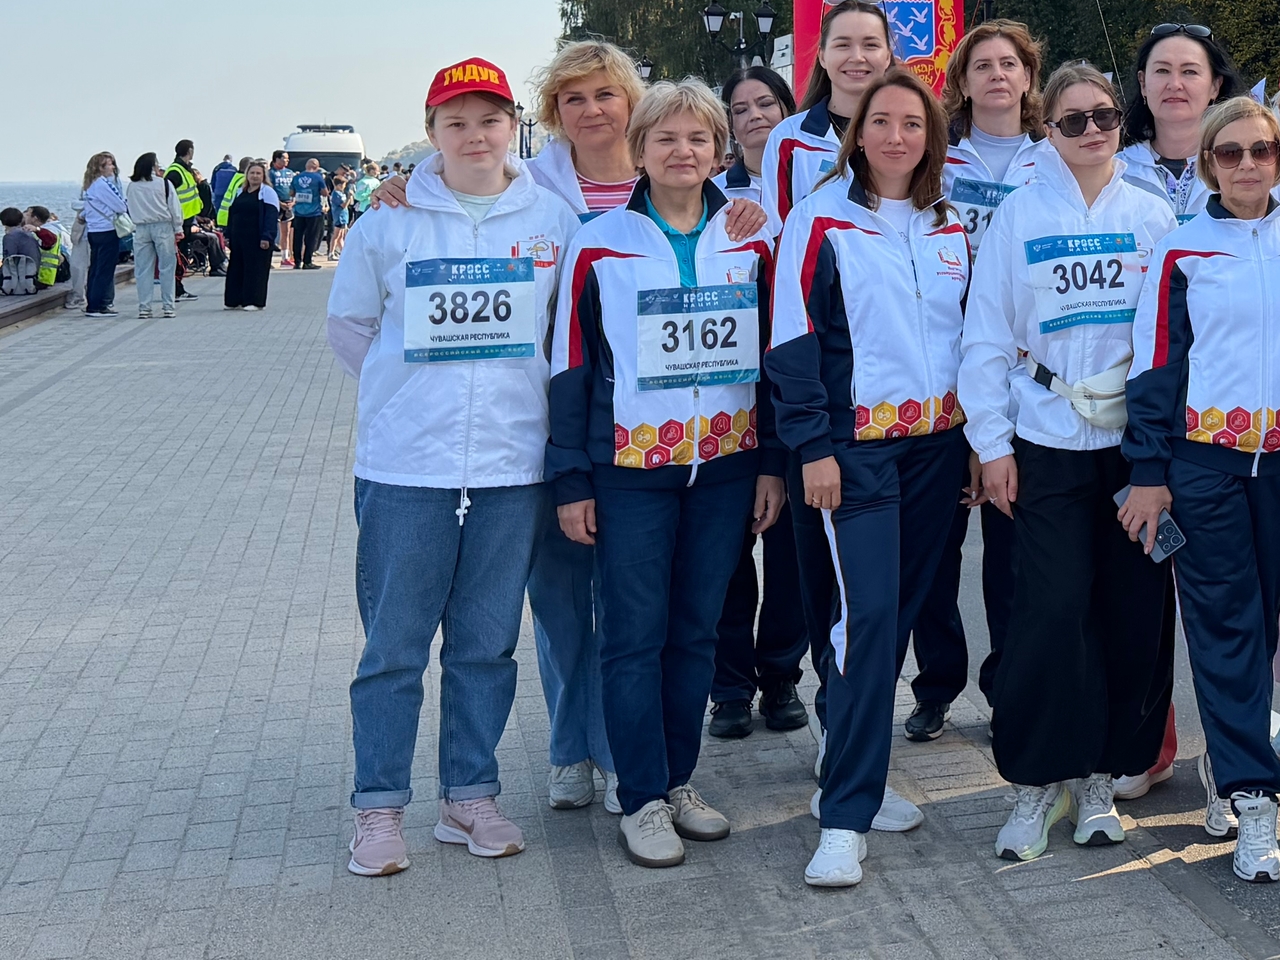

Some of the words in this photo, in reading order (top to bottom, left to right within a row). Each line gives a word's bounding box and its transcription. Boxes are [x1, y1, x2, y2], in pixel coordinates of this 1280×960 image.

[444, 64, 500, 86] ГИДУВ
[1068, 238, 1100, 248] КРОСС
[452, 264, 490, 275] КРОСС
[1052, 259, 1124, 294] 3042
[683, 291, 718, 303] КРОСС
[428, 289, 512, 325] 3826
[430, 334, 469, 342] ЧУВАШСКАЯ
[470, 332, 510, 341] РЕСПУБЛИКА
[661, 317, 737, 353] 3162
[665, 362, 700, 371] ЧУВАШСКАЯ
[701, 359, 738, 368] РЕСПУБЛИКА
